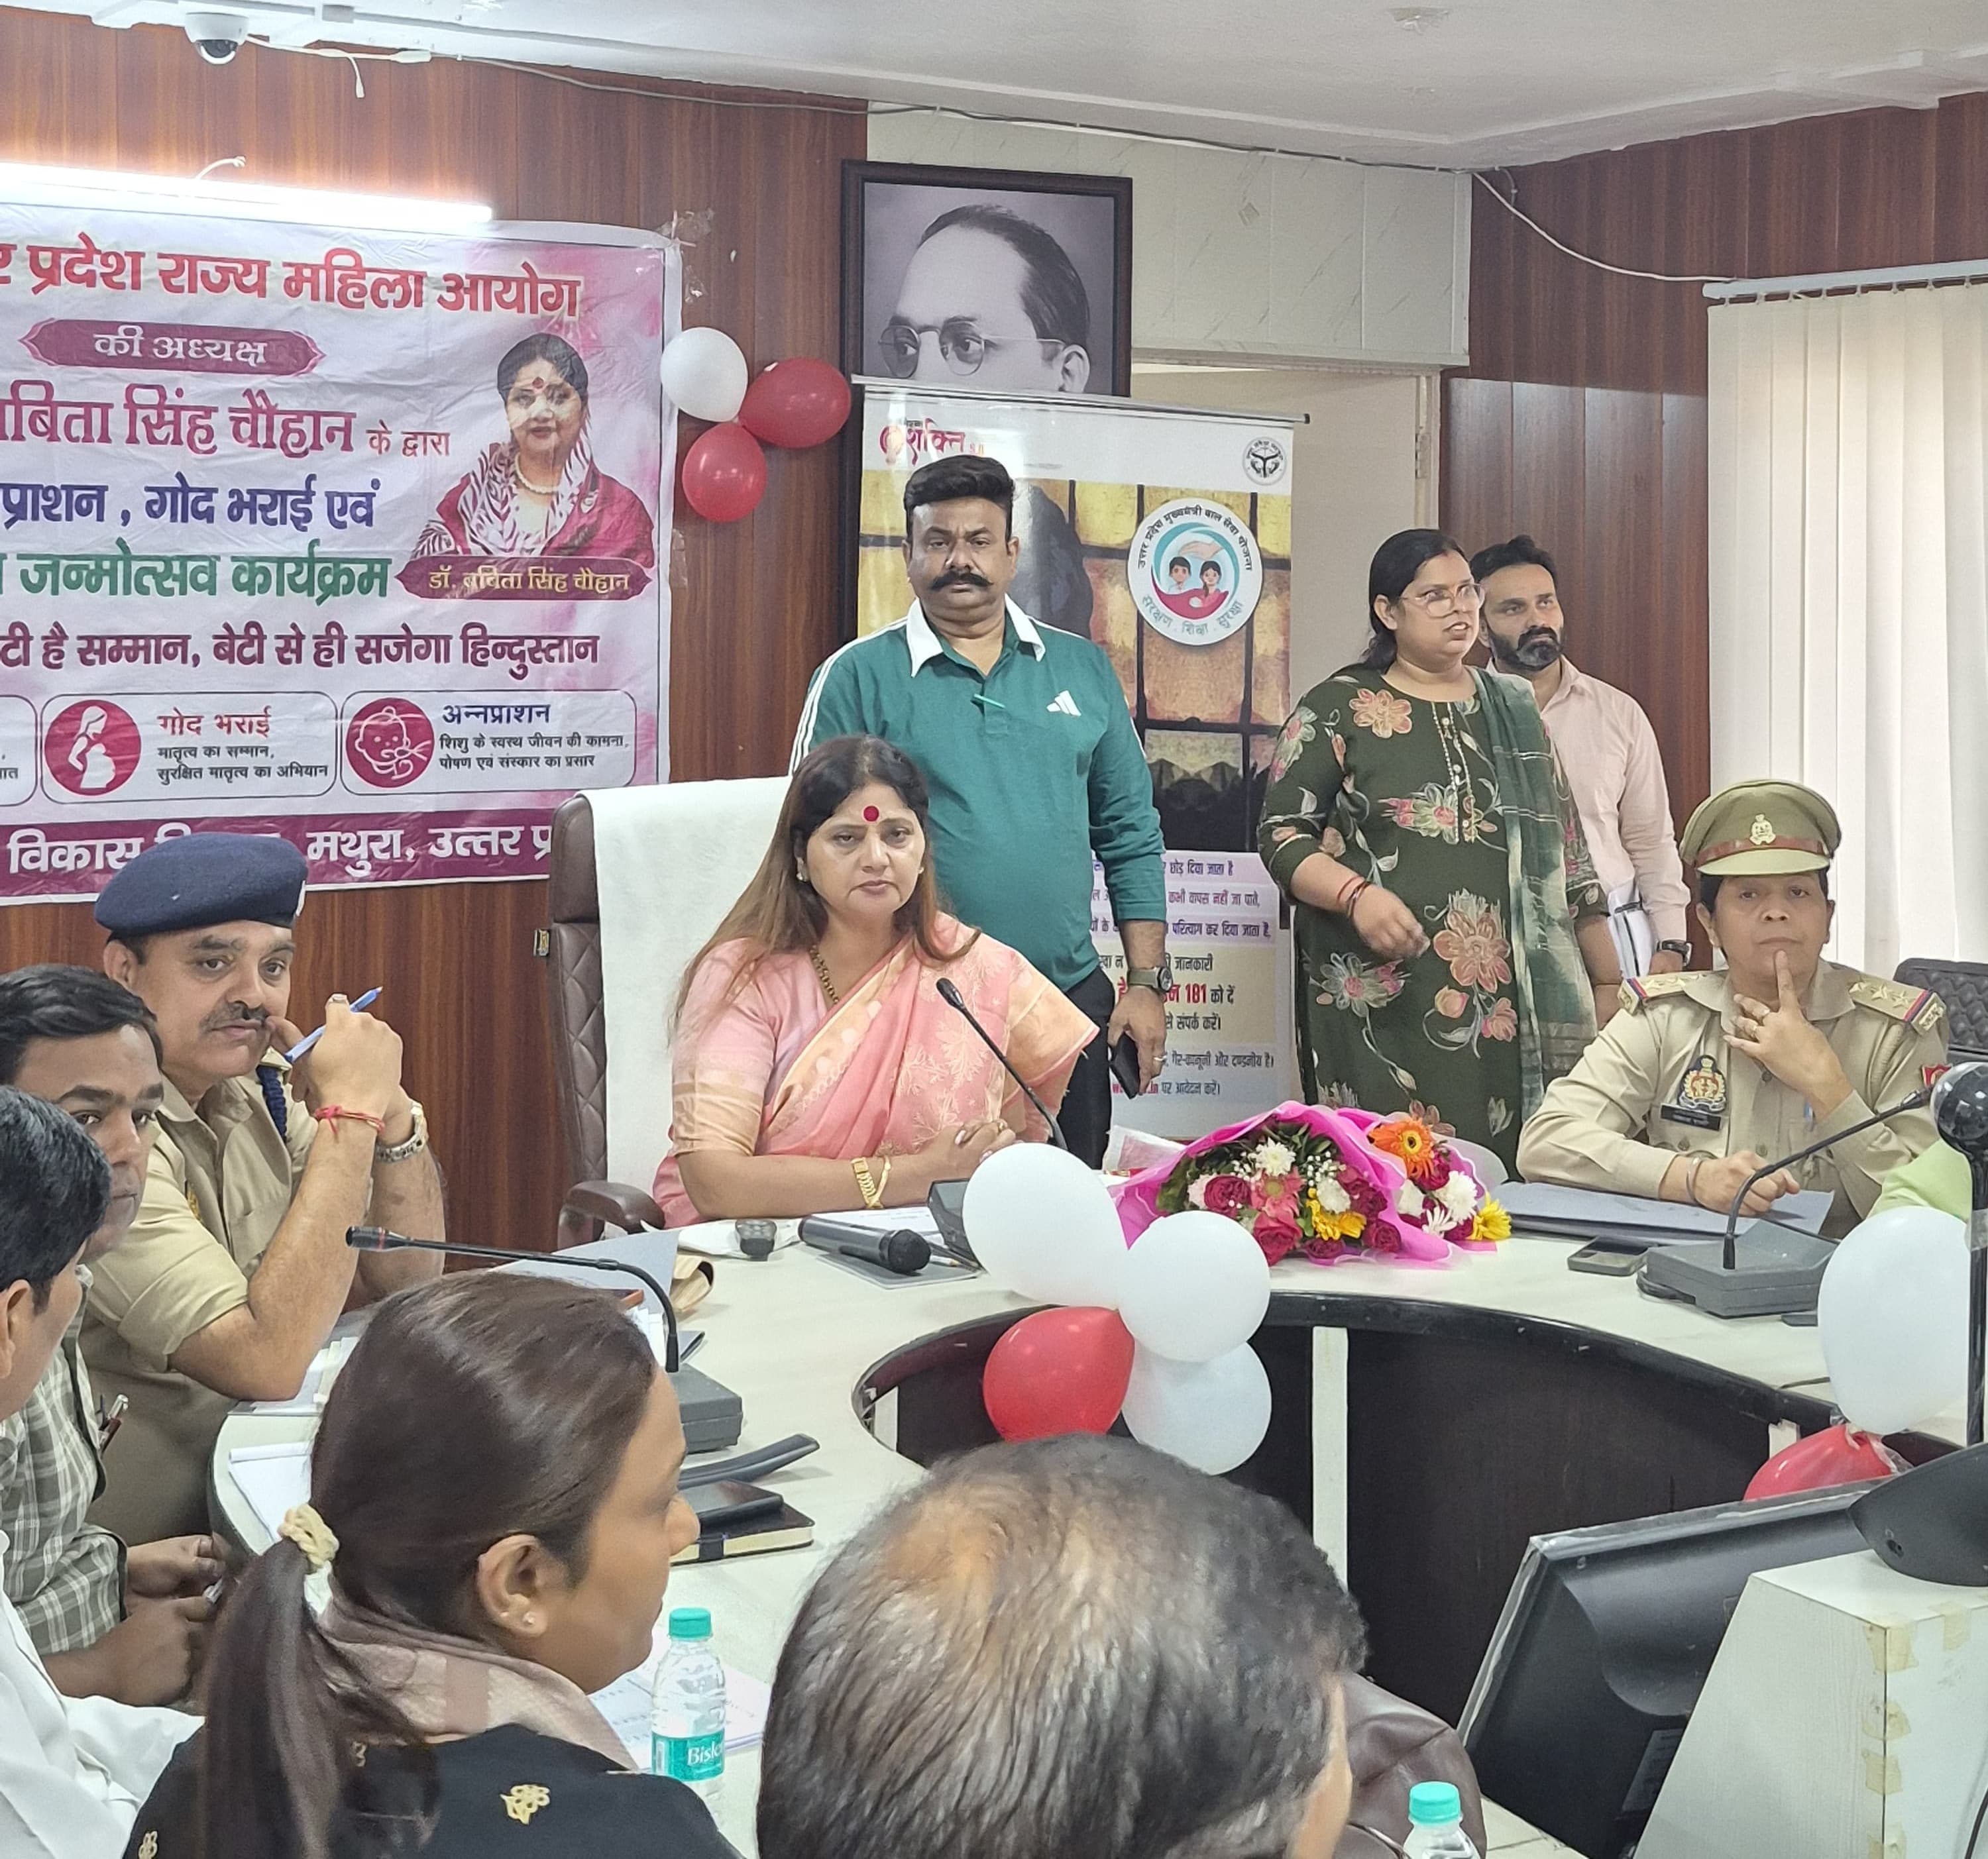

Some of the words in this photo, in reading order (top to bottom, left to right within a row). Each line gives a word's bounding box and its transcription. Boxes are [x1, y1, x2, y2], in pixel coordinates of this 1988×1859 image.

[27, 231, 146, 295] प्रदेश
[158, 253, 271, 298] राज्य
[282, 248, 427, 309] महिला
[437, 261, 581, 317] आयोग
[93, 325, 144, 357] की
[153, 337, 267, 366] अध्यक्ष
[0, 380, 114, 443] बिता
[124, 384, 219, 454] सिंह
[228, 388, 357, 458] चौहान
[366, 419, 392, 455] के
[401, 431, 450, 456] द्वारा
[144, 471, 219, 524] गोद
[227, 473, 317, 532] भराई
[325, 478, 380, 529] एवं
[17, 537, 221, 596] जन्मोत्सव
[231, 538, 392, 606] कार्यक्रम
[528, 566, 568, 593] सिंह
[573, 568, 630, 594] चौहान
[41, 621, 69, 669] है
[77, 634, 200, 667] सम्मान,
[212, 621, 267, 666] बेटी
[274, 622, 305, 665] से
[312, 621, 348, 667] ही
[355, 623, 453, 664] सजेगा
[460, 622, 600, 680] हिन्दुस्तान
[157, 707, 204, 735] गोद
[215, 706, 271, 737] भराई
[442, 704, 551, 724] अन्नप्राशन
[158, 747, 197, 763] मातृत्व
[203, 746, 220, 757] का
[226, 746, 274, 759] सम्मान,
[439, 733, 469, 754] शिशु
[472, 733, 486, 748] के
[490, 736, 523, 748] स्वस्थ
[528, 732, 563, 748] जीवन
[567, 731, 581, 747] की
[157, 763, 203, 786] सुरक्षित
[208, 766, 248, 783] मातृत्व
[254, 766, 271, 778] का
[276, 761, 328, 776] अभियान
[439, 754, 471, 770] पोषण
[476, 753, 494, 770] एवं
[498, 753, 540, 769] संस्कार
[544, 755, 561, 768] का
[565, 755, 595, 767] प्रसार
[306, 829, 415, 878] मथुरा,
[428, 826, 524, 857] उत्तर
[1174, 953, 1213, 971] जानकारी
[1185, 983, 1207, 1003] 181
[1210, 984, 1224, 1004] को
